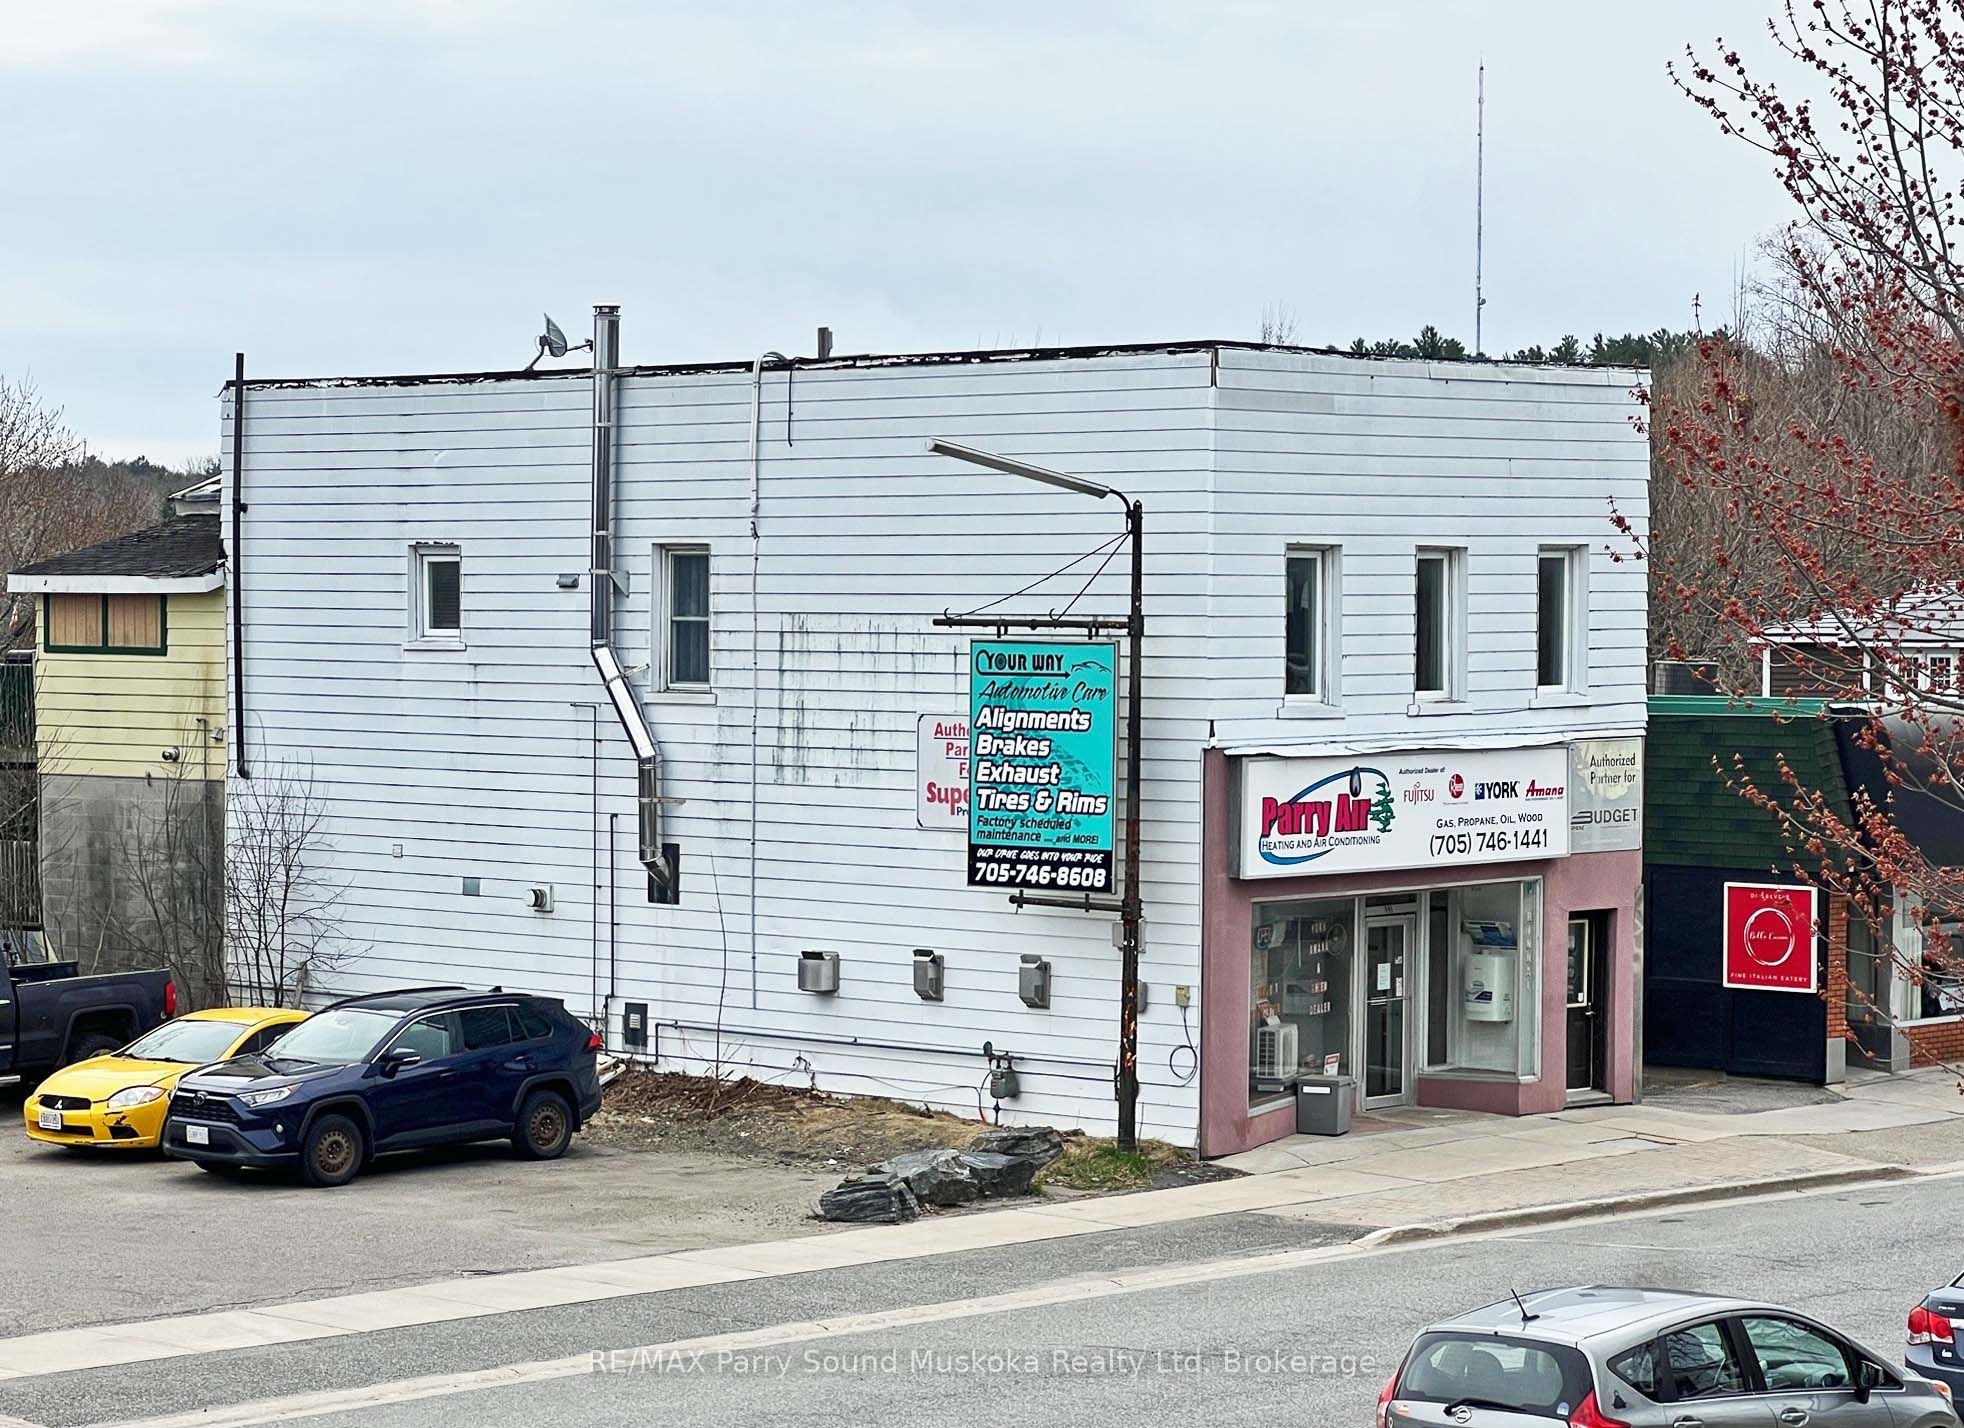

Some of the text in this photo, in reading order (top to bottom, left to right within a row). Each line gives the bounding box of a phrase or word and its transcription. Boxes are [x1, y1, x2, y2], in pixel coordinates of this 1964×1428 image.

[986, 652, 1065, 671] YOUR WAY
[978, 680, 1108, 702] Automotive Care
[975, 706, 1091, 732] Alignments
[934, 721, 969, 737] Auth
[976, 733, 1051, 757] Brakes
[1589, 752, 1636, 768] Authorized
[976, 761, 1060, 785] Exhaust
[1398, 767, 1424, 775] Authorized
[1623, 769, 1636, 783] for
[1403, 786, 1435, 806] FUJITSU
[1485, 781, 1519, 800] YORK
[1525, 779, 1565, 798] Amana
[977, 788, 1107, 814] Tires & Rims
[977, 815, 1071, 831] Factory scheduled
[1261, 793, 1372, 838] Parry Air
[1457, 816, 1499, 828] PROPANE,
[1517, 813, 1543, 823] WOOD
[1570, 808, 1638, 825] BUDGET
[976, 828, 1042, 843] maintenance
[1072, 835, 1099, 845] MORE!
[1262, 835, 1381, 851] HEATING AND AIR CONDITIONING
[1429, 828, 1548, 857] (705) 746-1441
[976, 847, 993, 858] OUR
[1019, 849, 1040, 860] GOES
[974, 862, 1107, 888] 705-746-8608
[1730, 971, 1808, 983] FINE ITALIAN EATERY
